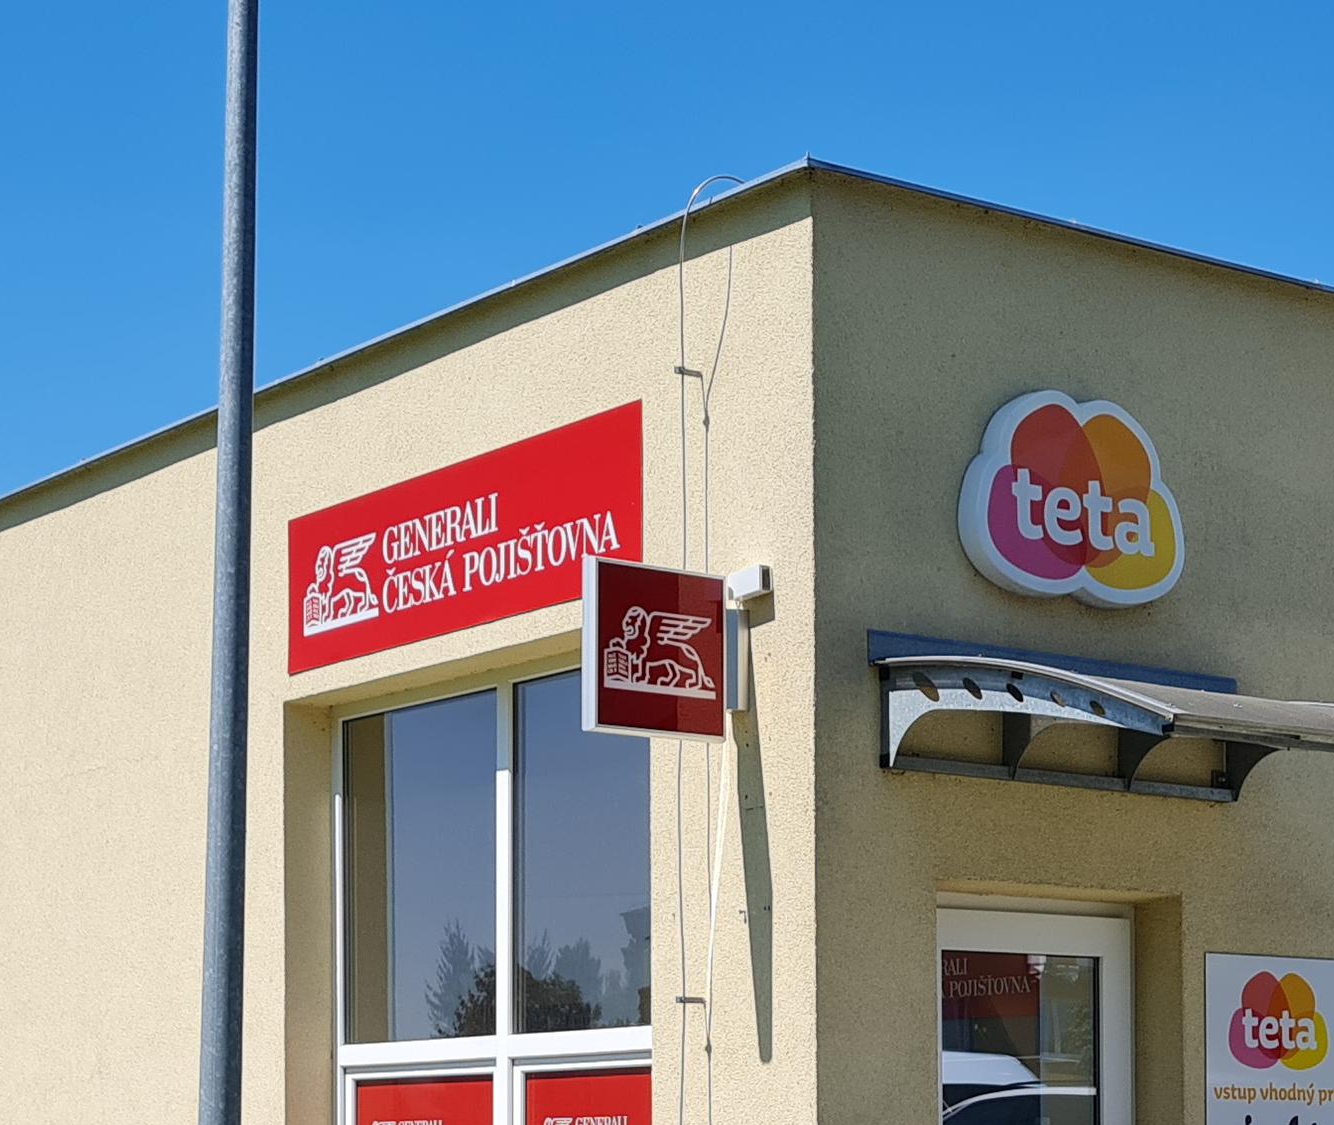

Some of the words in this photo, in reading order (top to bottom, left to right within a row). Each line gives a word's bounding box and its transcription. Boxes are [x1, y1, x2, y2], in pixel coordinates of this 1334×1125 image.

[381, 492, 499, 565] GENERALI
[1012, 466, 1155, 557] teta
[381, 549, 456, 615] ČESKÁ
[463, 510, 621, 594] POJIŠŤOVNA
[943, 958, 968, 976] RALI
[949, 975, 1031, 998] POJIŠŤOVNA
[1241, 1008, 1317, 1050] teta
[1214, 1084, 1257, 1103] vstup
[1260, 1082, 1315, 1106] vhodný
